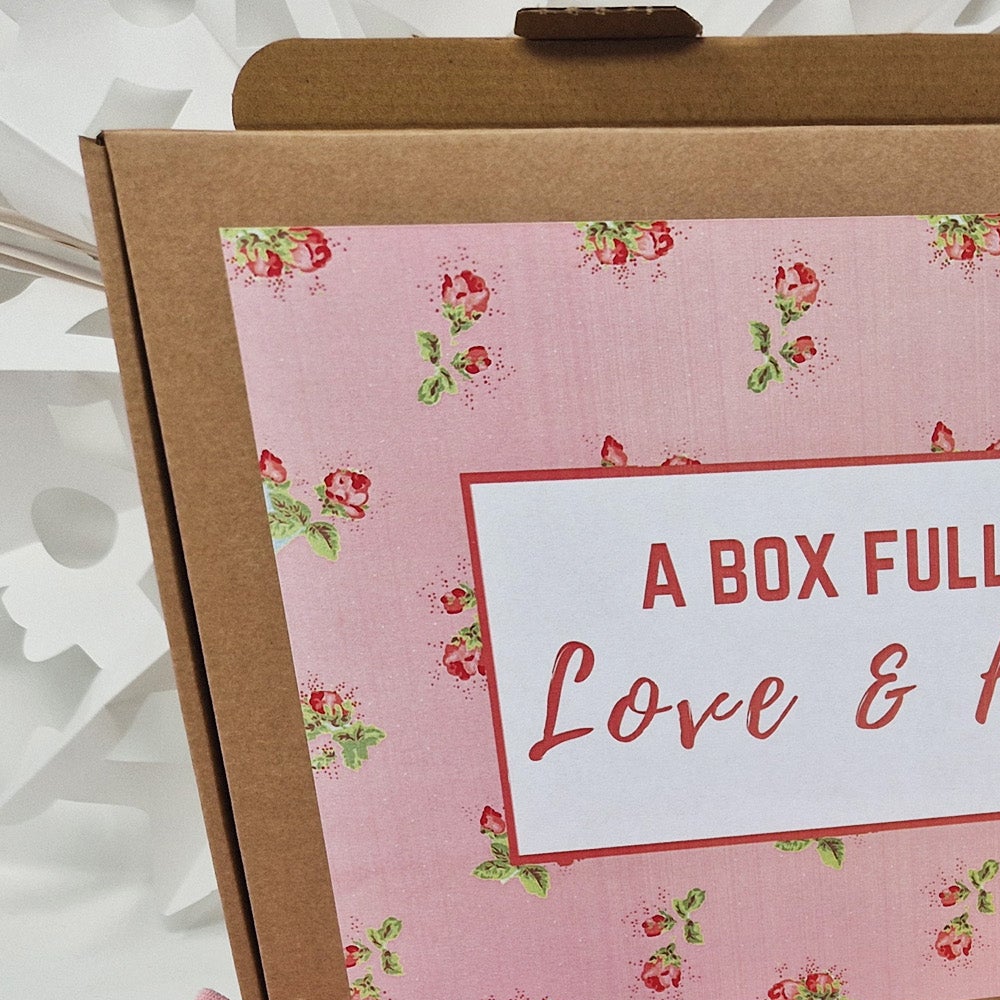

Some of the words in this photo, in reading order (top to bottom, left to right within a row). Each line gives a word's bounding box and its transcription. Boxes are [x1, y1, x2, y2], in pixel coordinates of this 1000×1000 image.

[642, 543, 686, 609] A
[712, 533, 839, 605] BOX
[528, 640, 798, 761] Love
[855, 643, 917, 730] &
